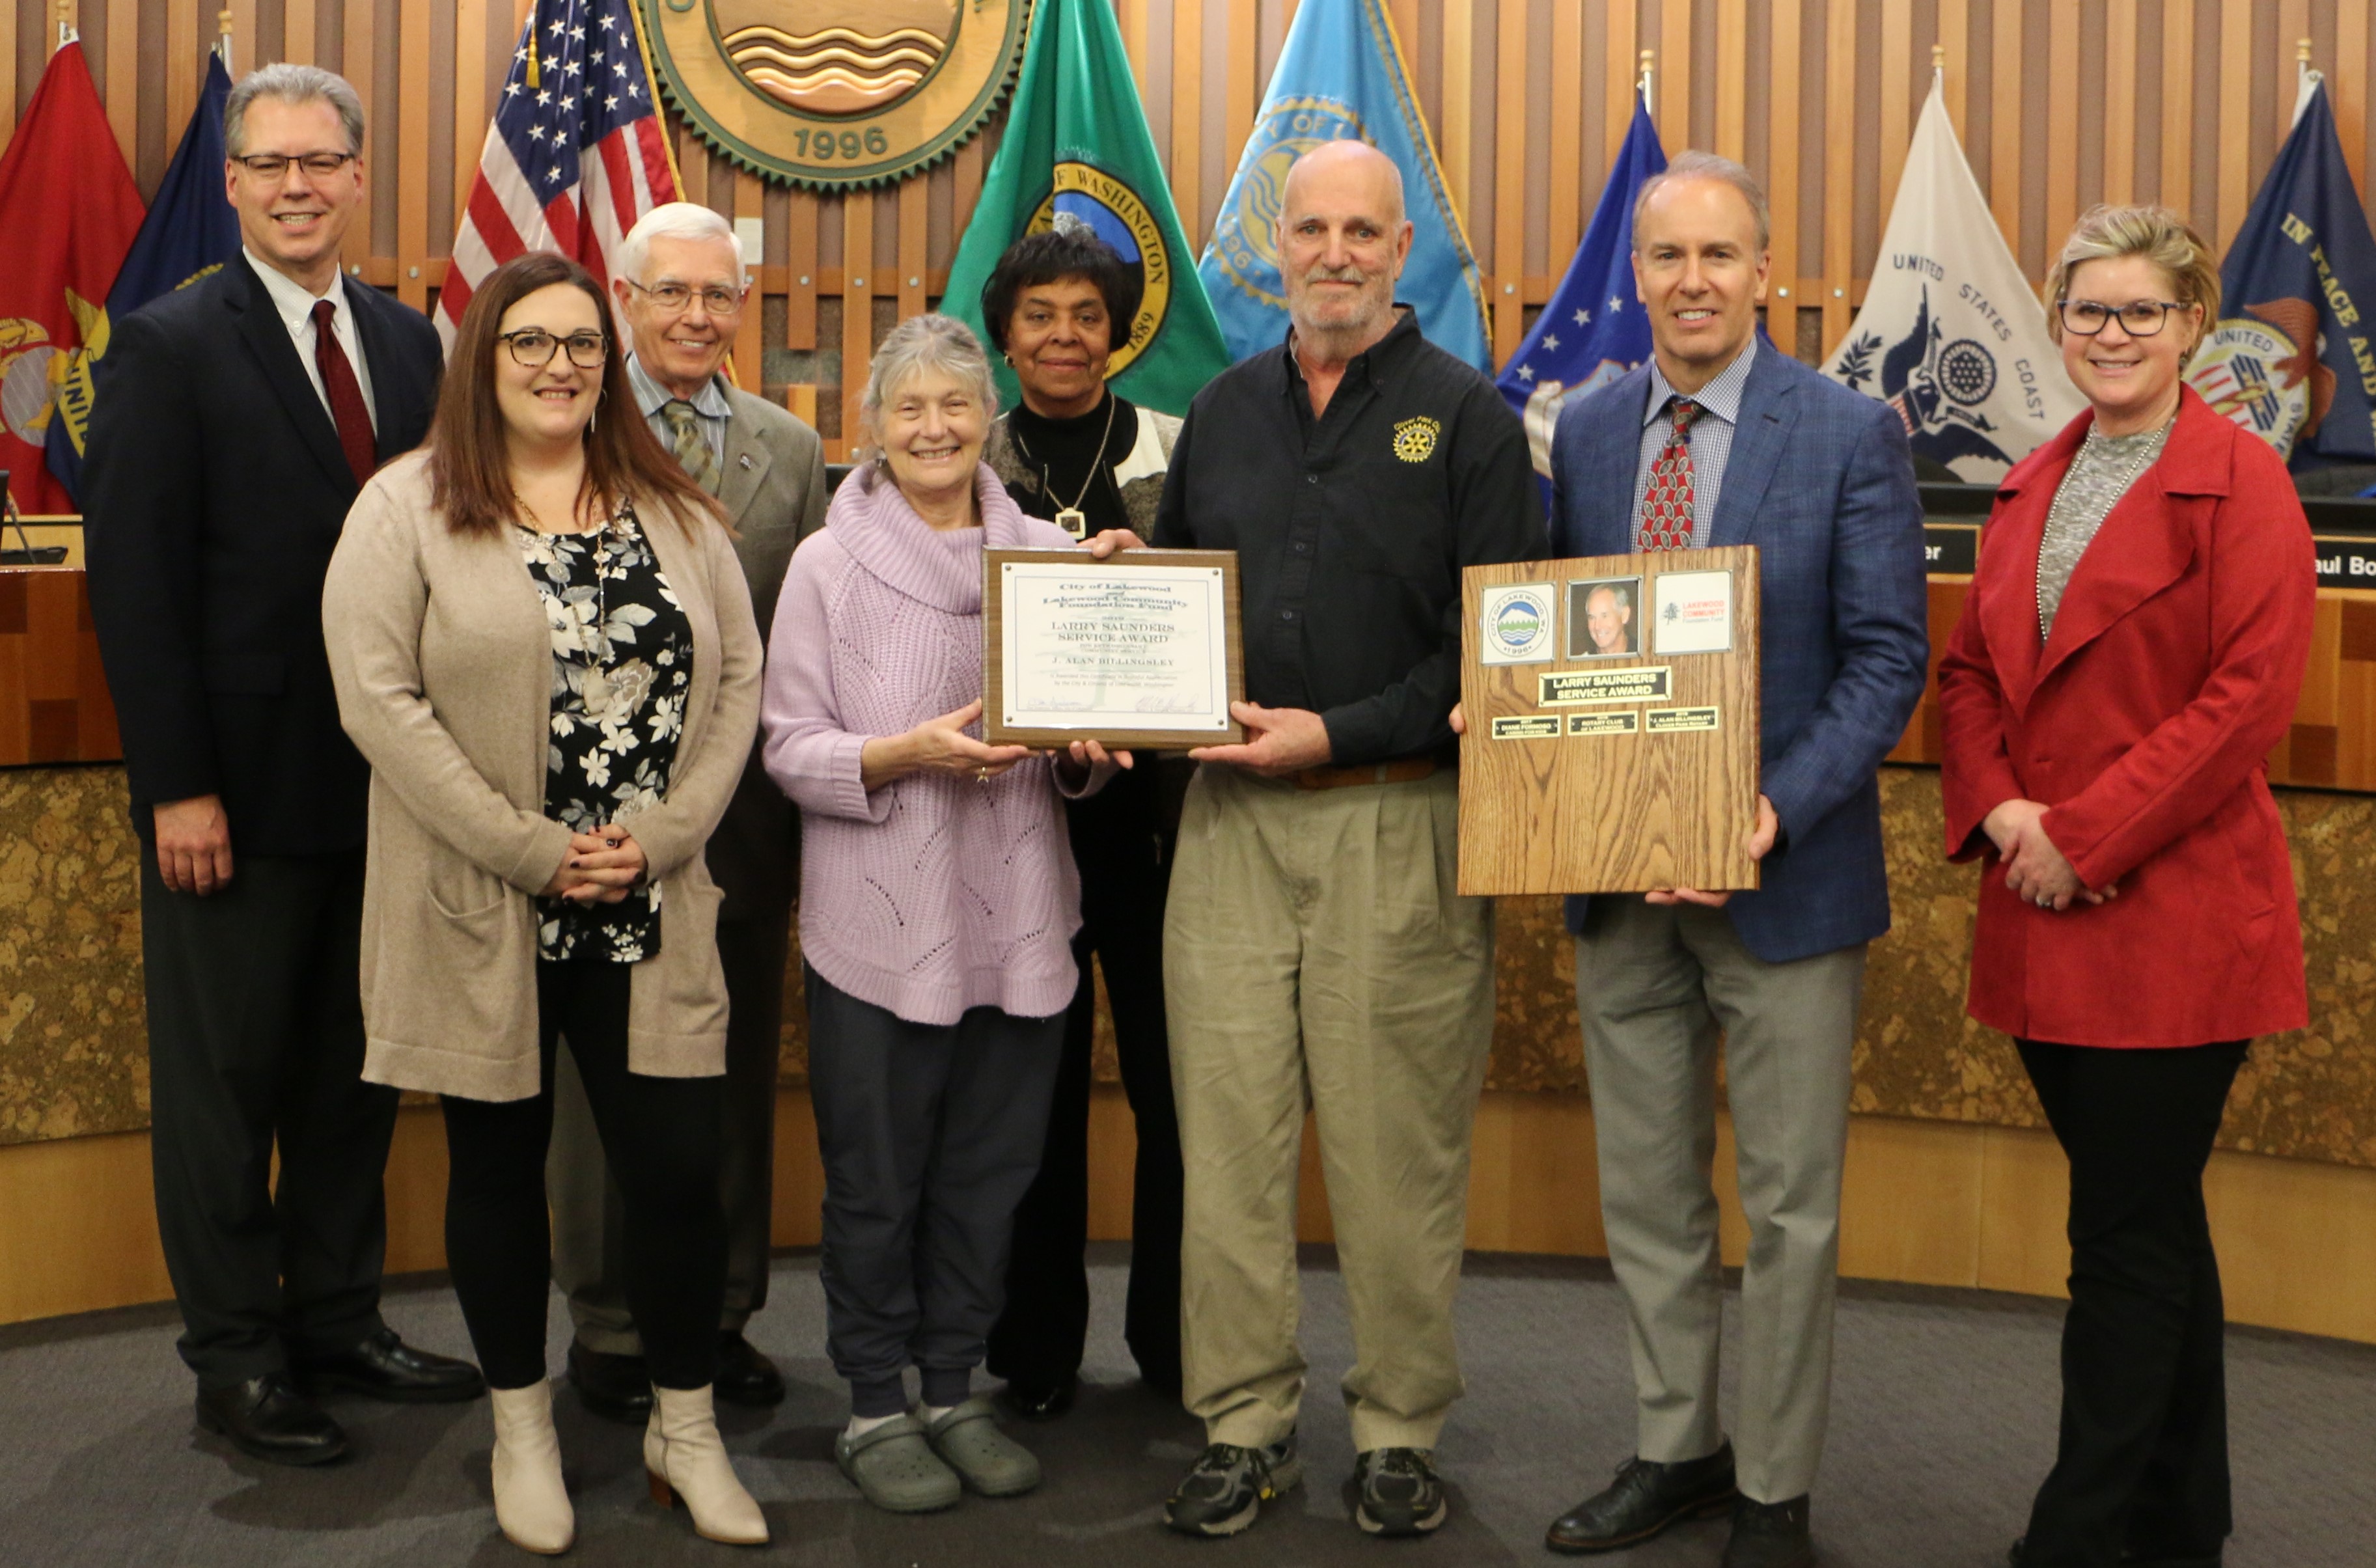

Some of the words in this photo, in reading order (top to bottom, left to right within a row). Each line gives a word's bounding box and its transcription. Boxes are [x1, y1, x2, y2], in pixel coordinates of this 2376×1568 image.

[1293, 114, 1328, 133] OF
[794, 126, 888, 159] 1996
[1077, 169, 1164, 286] WASHINGTON
[2281, 212, 2314, 245] IN
[1128, 312, 1154, 351] 1889
[1893, 254, 1944, 281] UNITED
[1959, 284, 2012, 342] STATES
[2015, 359, 2045, 420] COAST
[2215, 329, 2274, 353] UNITED
[2274, 402, 2304, 454] STATE
[2314, 555, 2341, 573] aul
[1105, 583, 1171, 592] Lakewood
[1112, 596, 1188, 608] Community
[1139, 602, 1173, 611] Fund
[1493, 605, 1501, 614] OF
[1682, 600, 1724, 609] LAKEWOOD
[1682, 609, 1725, 618] COMMUNITY
[1052, 622, 1098, 630] LARRY
[1102, 622, 1174, 631] SAUNDERS
[1058, 633, 1116, 642] SERVICE
[1120, 634, 1168, 643] AWARD
[1553, 677, 1592, 689] LARRY
[1593, 673, 1657, 686] SAUNDERS
[1556, 687, 1607, 699] SERVICE
[1608, 685, 1653, 696] AWARD
